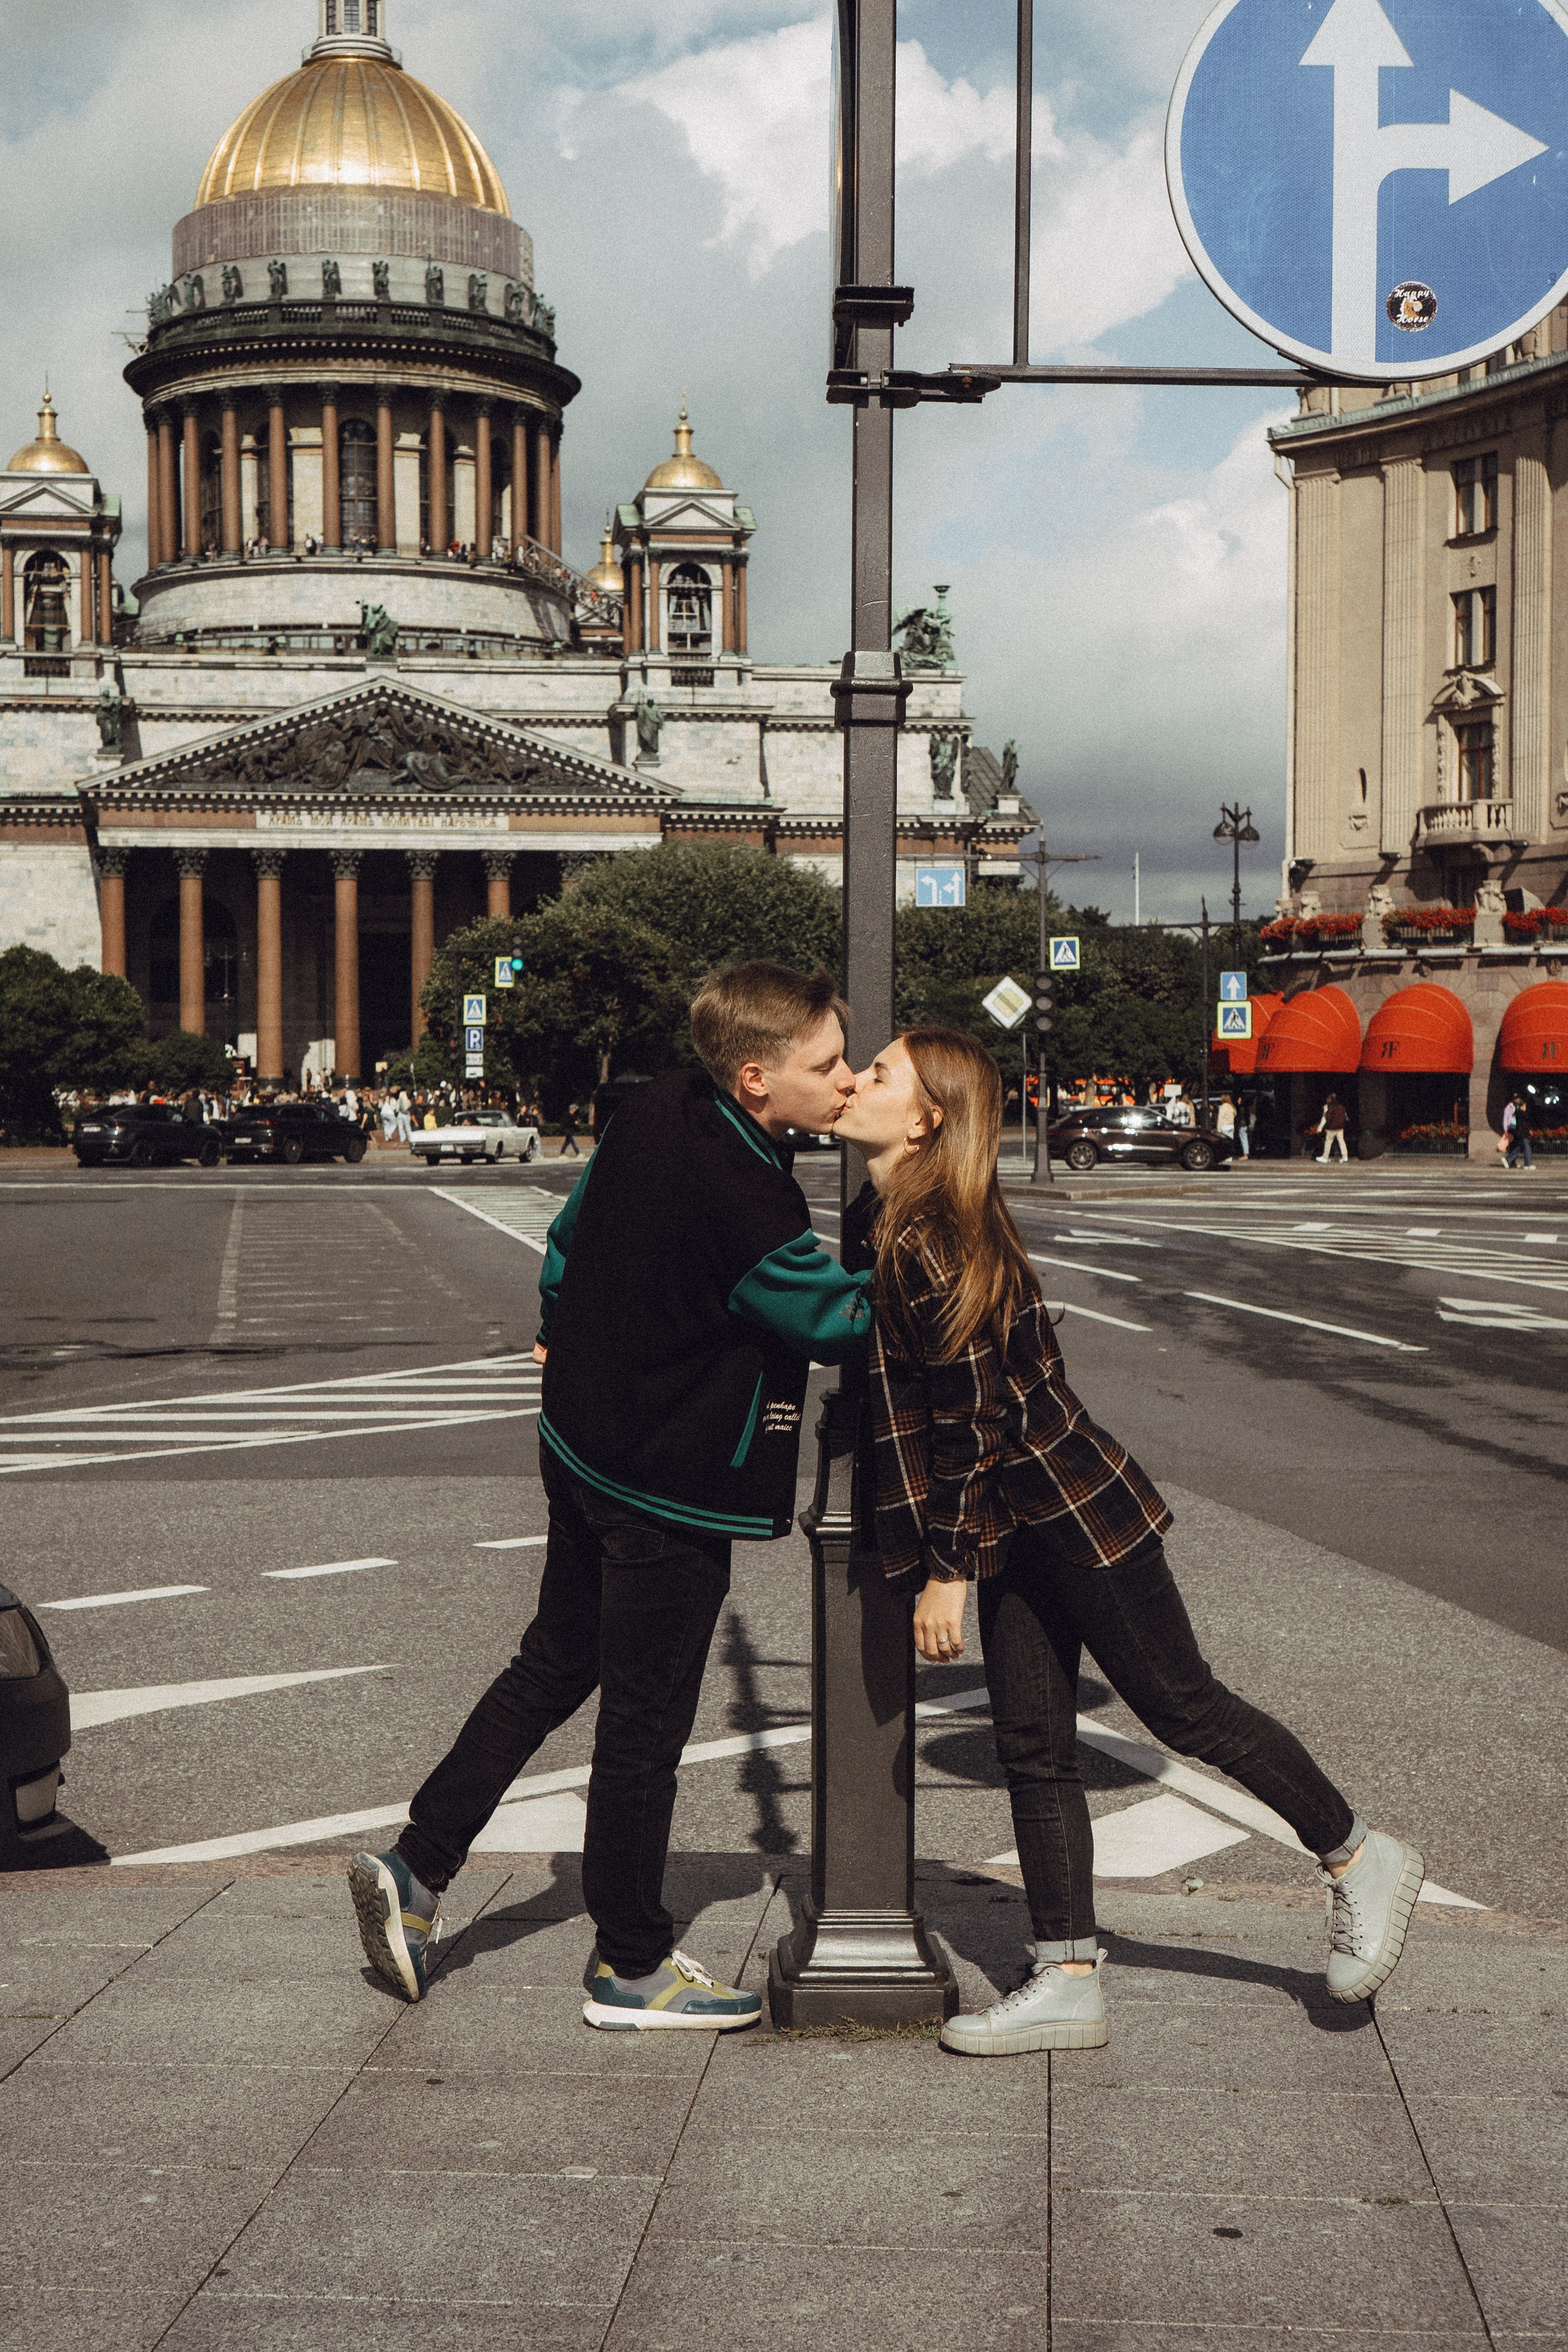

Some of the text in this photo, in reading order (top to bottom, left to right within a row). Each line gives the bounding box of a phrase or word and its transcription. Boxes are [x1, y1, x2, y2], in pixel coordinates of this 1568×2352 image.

[1395, 289, 1429, 298] Happy
[1396, 314, 1429, 323] Horse
[470, 1030, 480, 1048] P
